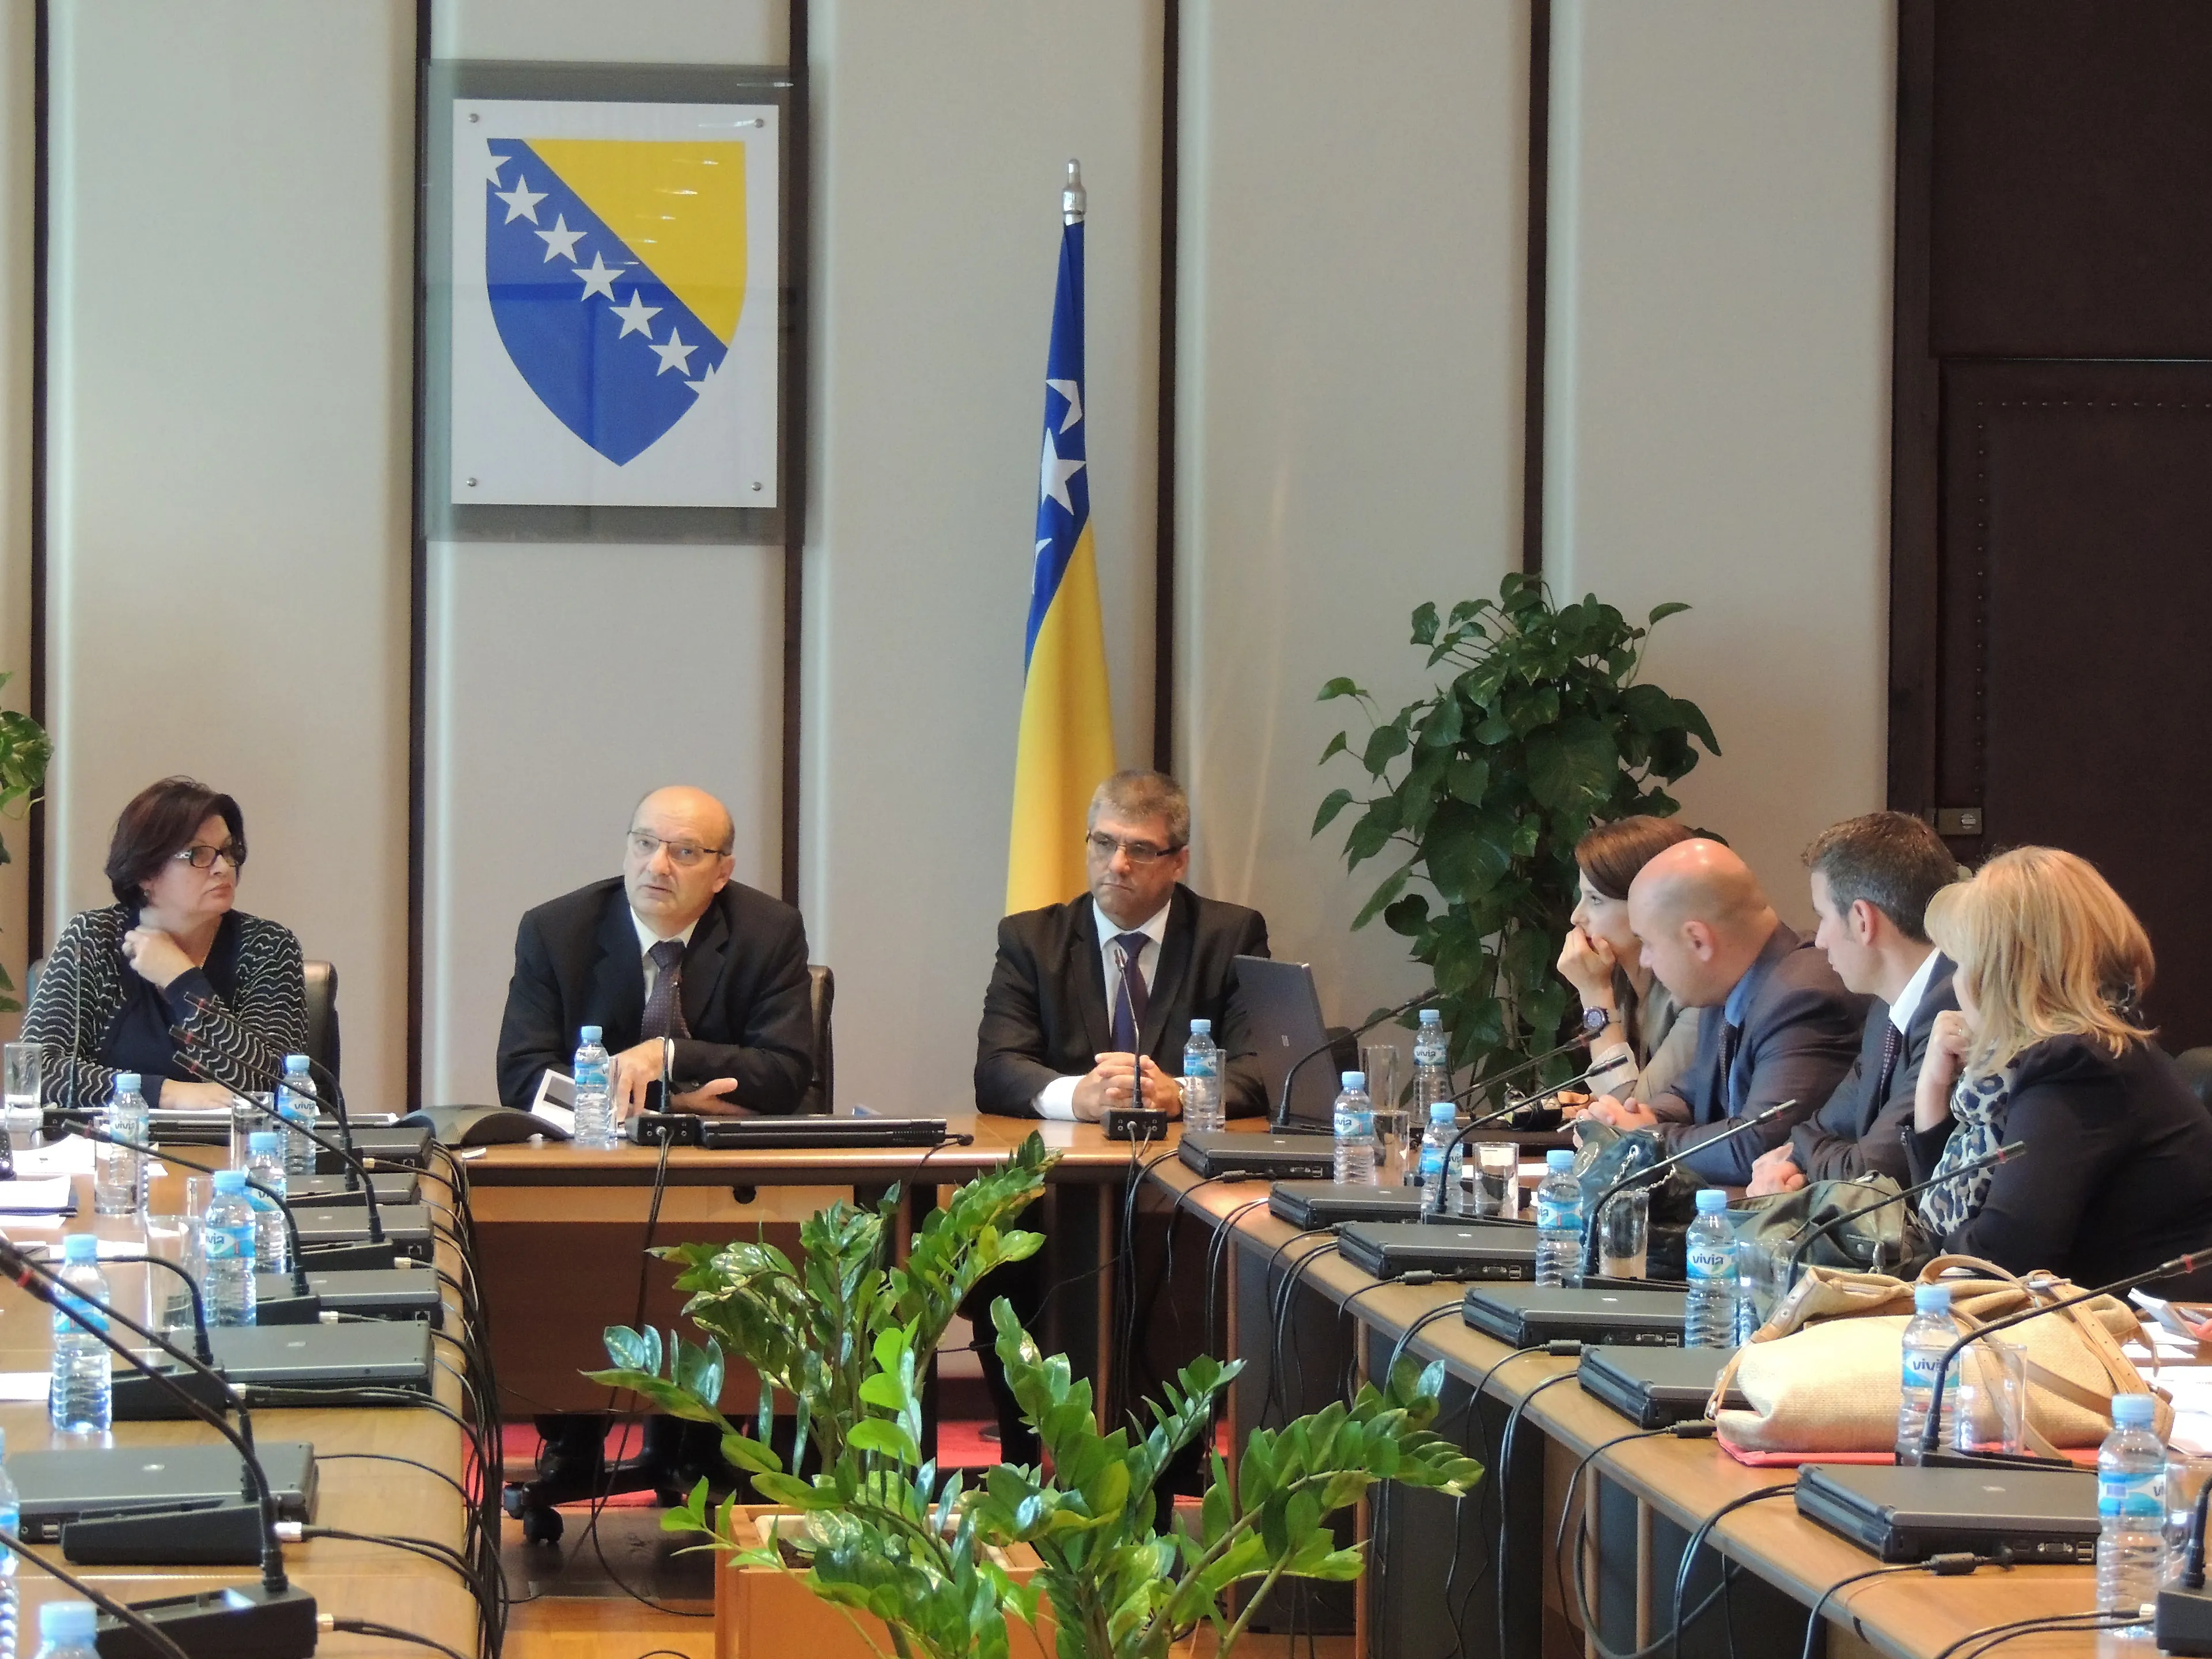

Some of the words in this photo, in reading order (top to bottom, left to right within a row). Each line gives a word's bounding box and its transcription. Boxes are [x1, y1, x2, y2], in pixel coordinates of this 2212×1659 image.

[294, 1101, 316, 1109] vivia
[115, 1121, 135, 1130] vivia
[1692, 1253, 1724, 1266] vivia
[1912, 1358, 1949, 1372] vivi
